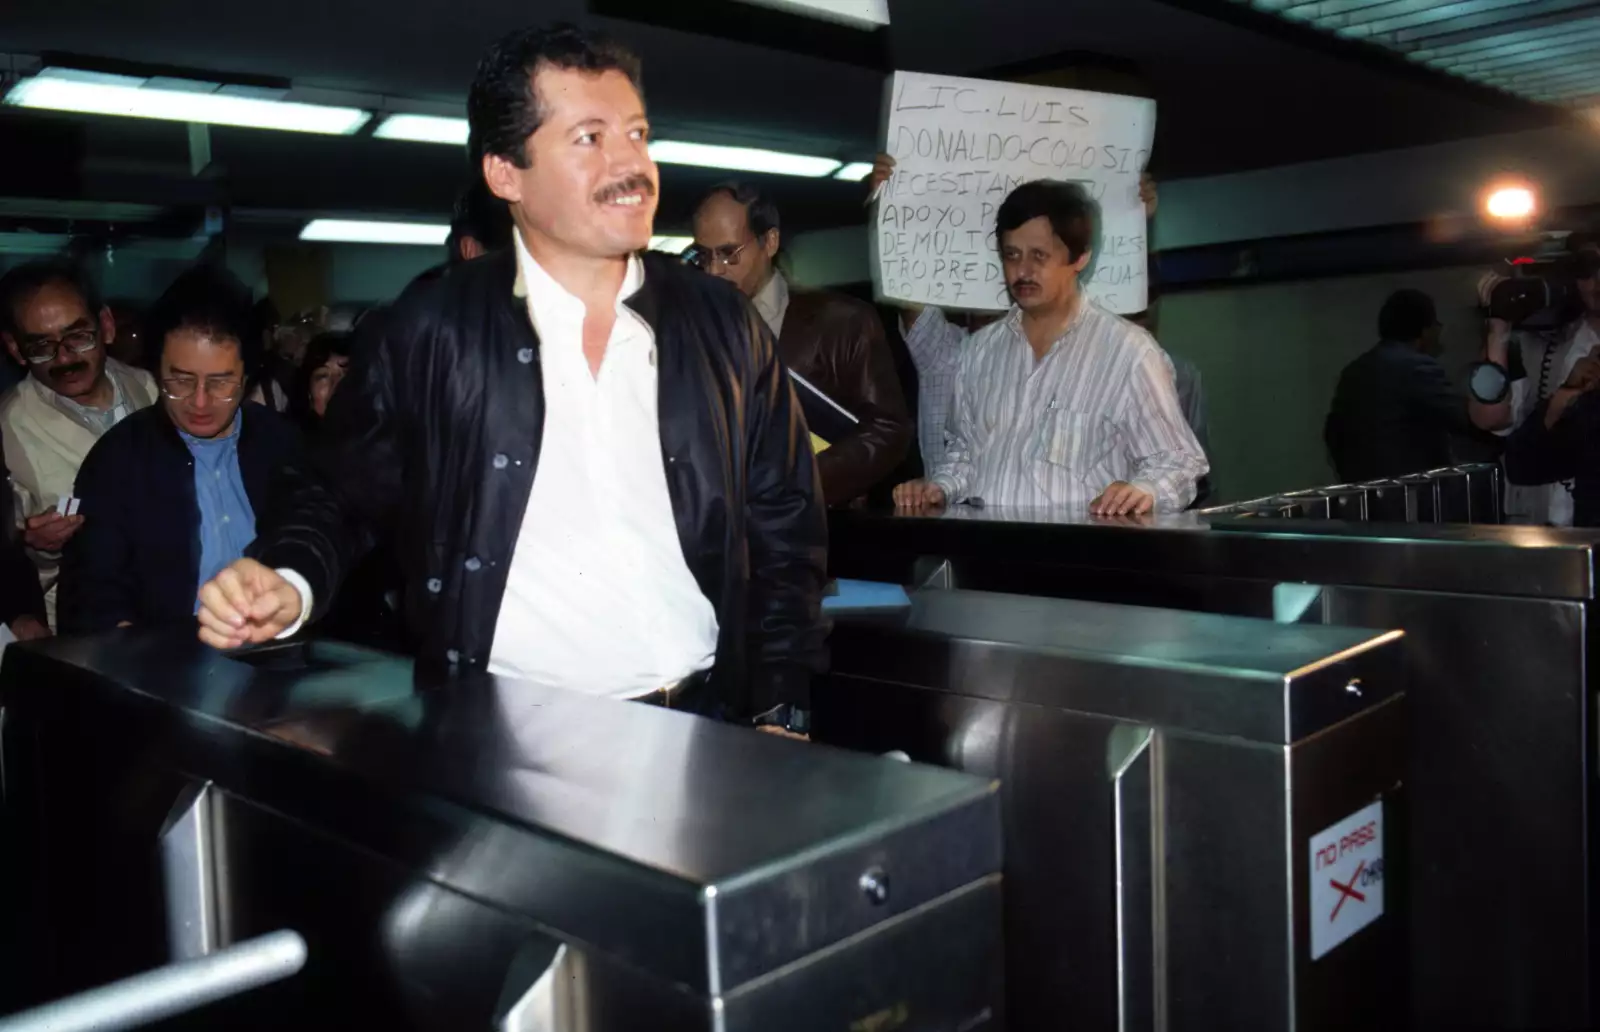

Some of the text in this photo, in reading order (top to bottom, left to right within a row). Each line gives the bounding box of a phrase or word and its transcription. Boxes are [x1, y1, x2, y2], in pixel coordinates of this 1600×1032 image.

[997, 95, 1090, 125] LUIS
[884, 169, 1024, 198] NECESITAM
[882, 203, 966, 230] APOYO
[883, 229, 1000, 256] DEMOLIC
